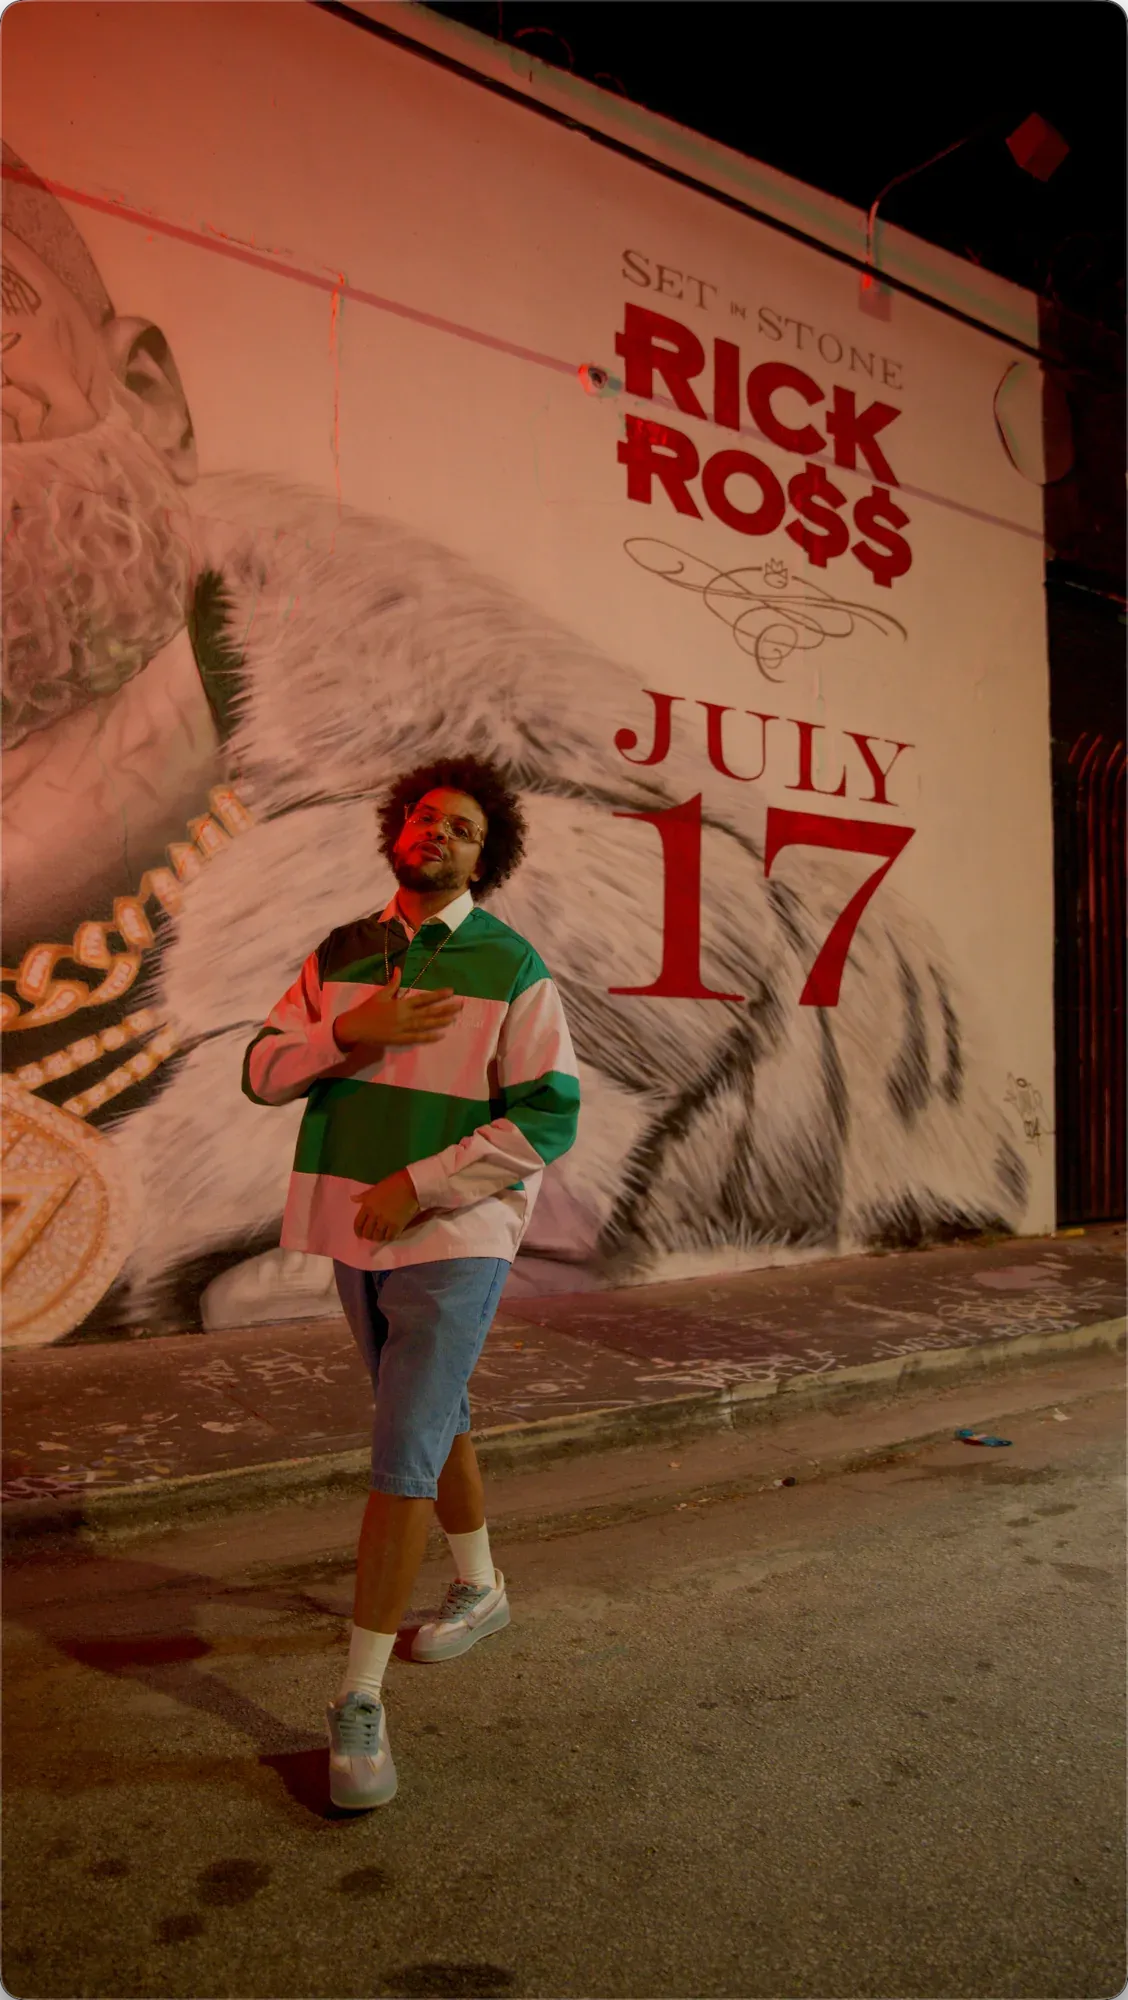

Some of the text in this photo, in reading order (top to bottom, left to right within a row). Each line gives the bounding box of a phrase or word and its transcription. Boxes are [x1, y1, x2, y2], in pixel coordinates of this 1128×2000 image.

[615, 302, 902, 488] RICK
[621, 249, 904, 390] SET IN STONE
[617, 413, 912, 589] RO$$
[613, 689, 916, 806] JULY
[608, 792, 916, 1007] 17
